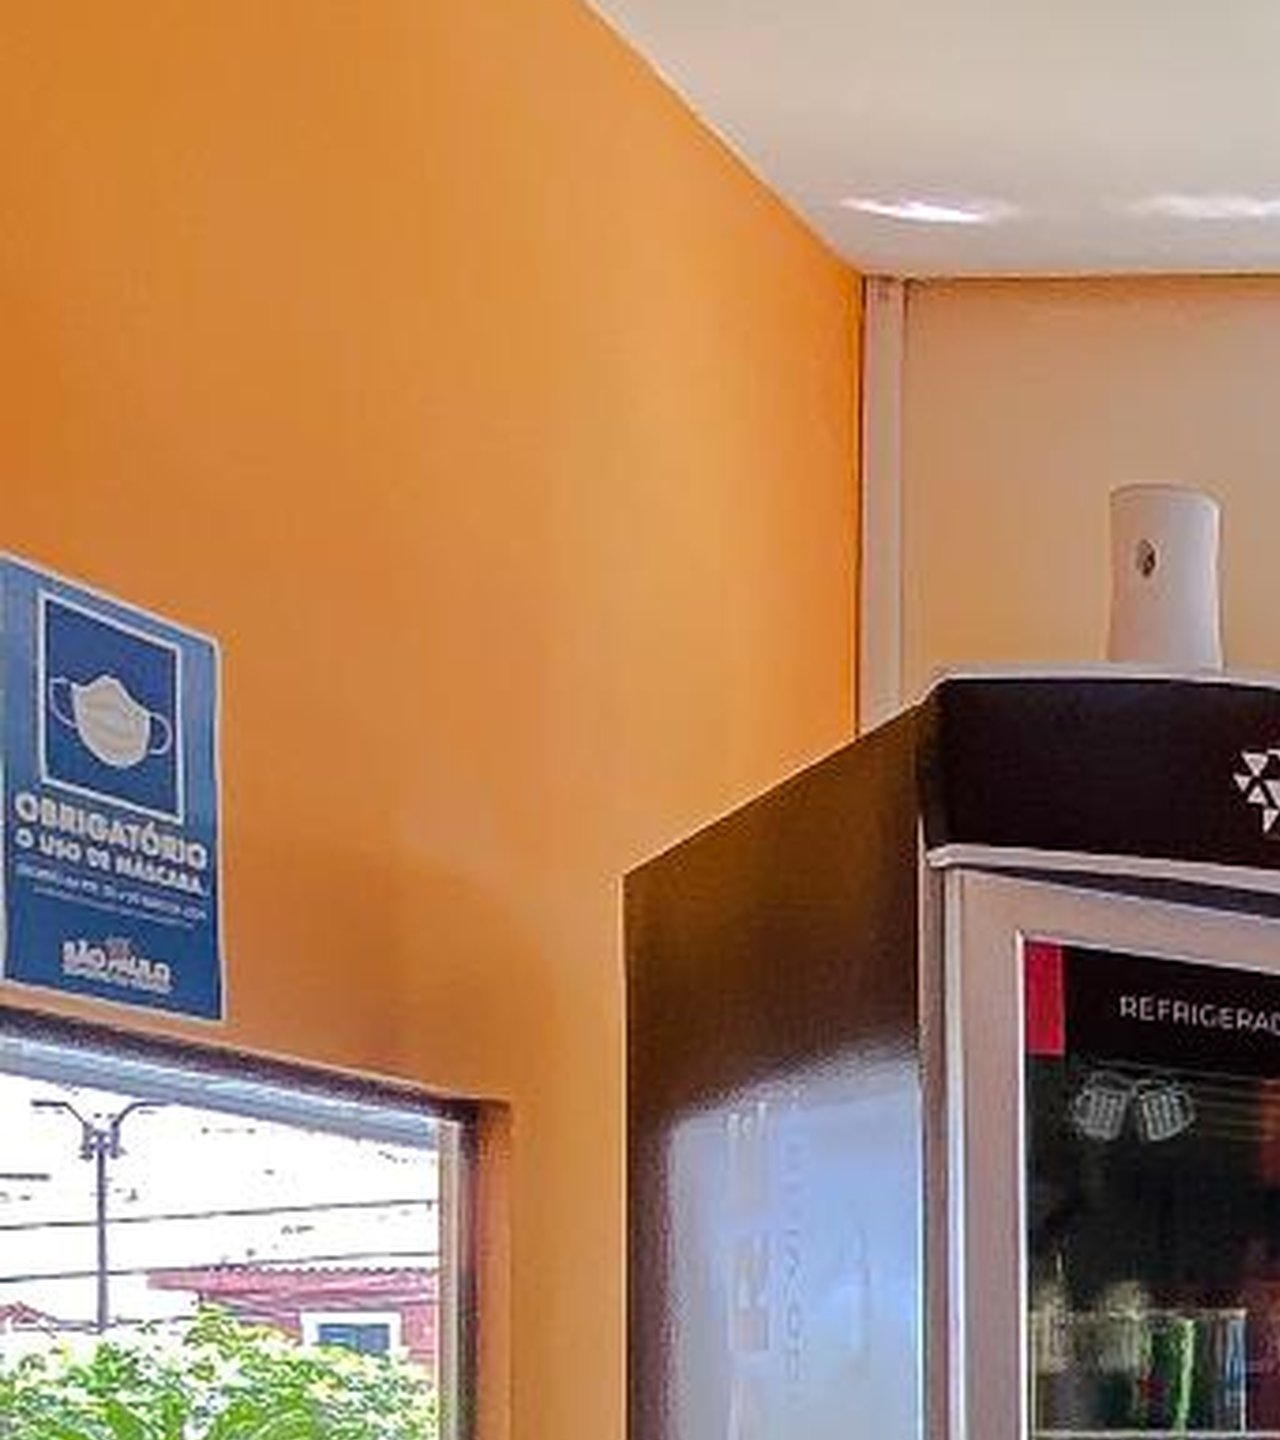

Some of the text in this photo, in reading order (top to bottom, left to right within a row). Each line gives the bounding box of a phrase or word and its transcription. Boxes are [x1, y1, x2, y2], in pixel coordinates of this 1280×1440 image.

[15, 791, 207, 871] OBRIGATÓRIO
[15, 827, 34, 848] O
[39, 834, 82, 862] USO
[86, 846, 111, 872] DE
